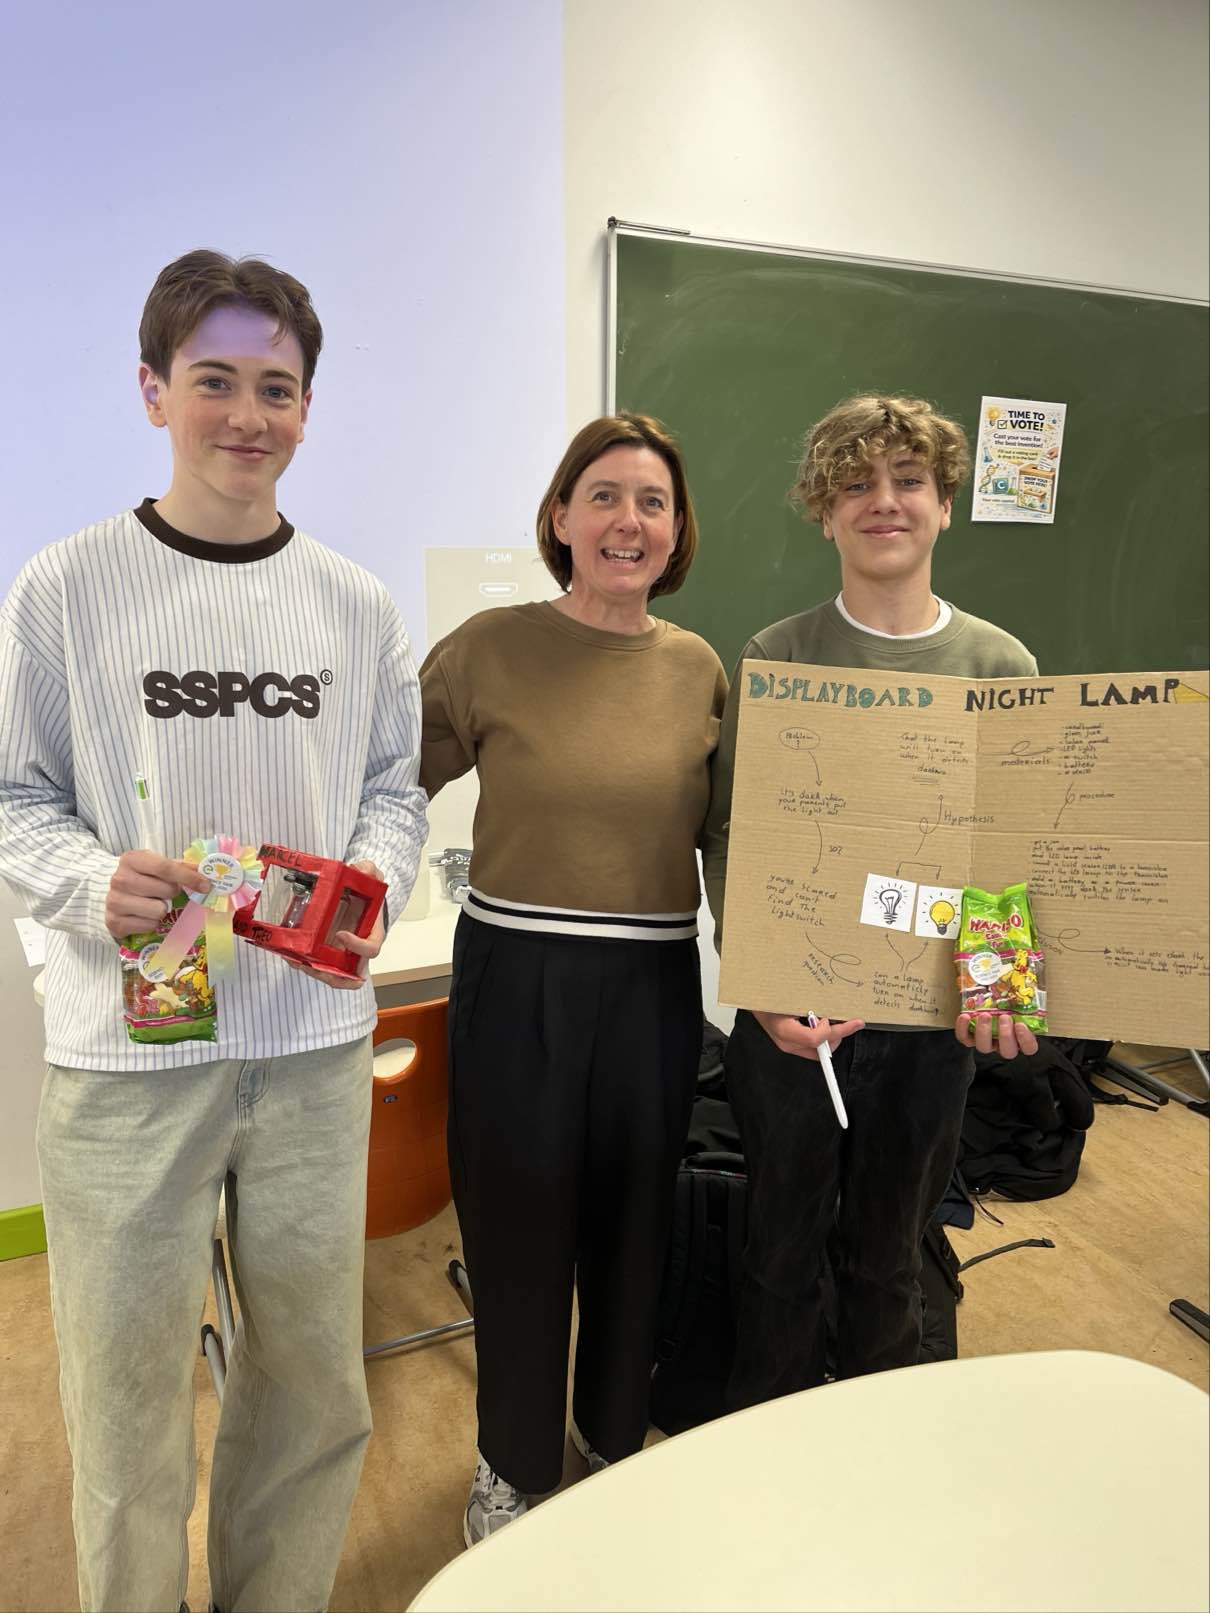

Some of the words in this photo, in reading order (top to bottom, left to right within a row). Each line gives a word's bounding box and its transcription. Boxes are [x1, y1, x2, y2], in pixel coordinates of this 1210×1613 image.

[1008, 410, 1031, 419] TIME
[1033, 412, 1045, 421] TO
[1010, 419, 1044, 431] VOTE!
[486, 551, 512, 563] HDMI
[143, 670, 320, 719] SSPCS
[964, 687, 1055, 712] NIGHT
[1080, 678, 1180, 706] LAMP
[943, 809, 994, 826] Hypothesis
